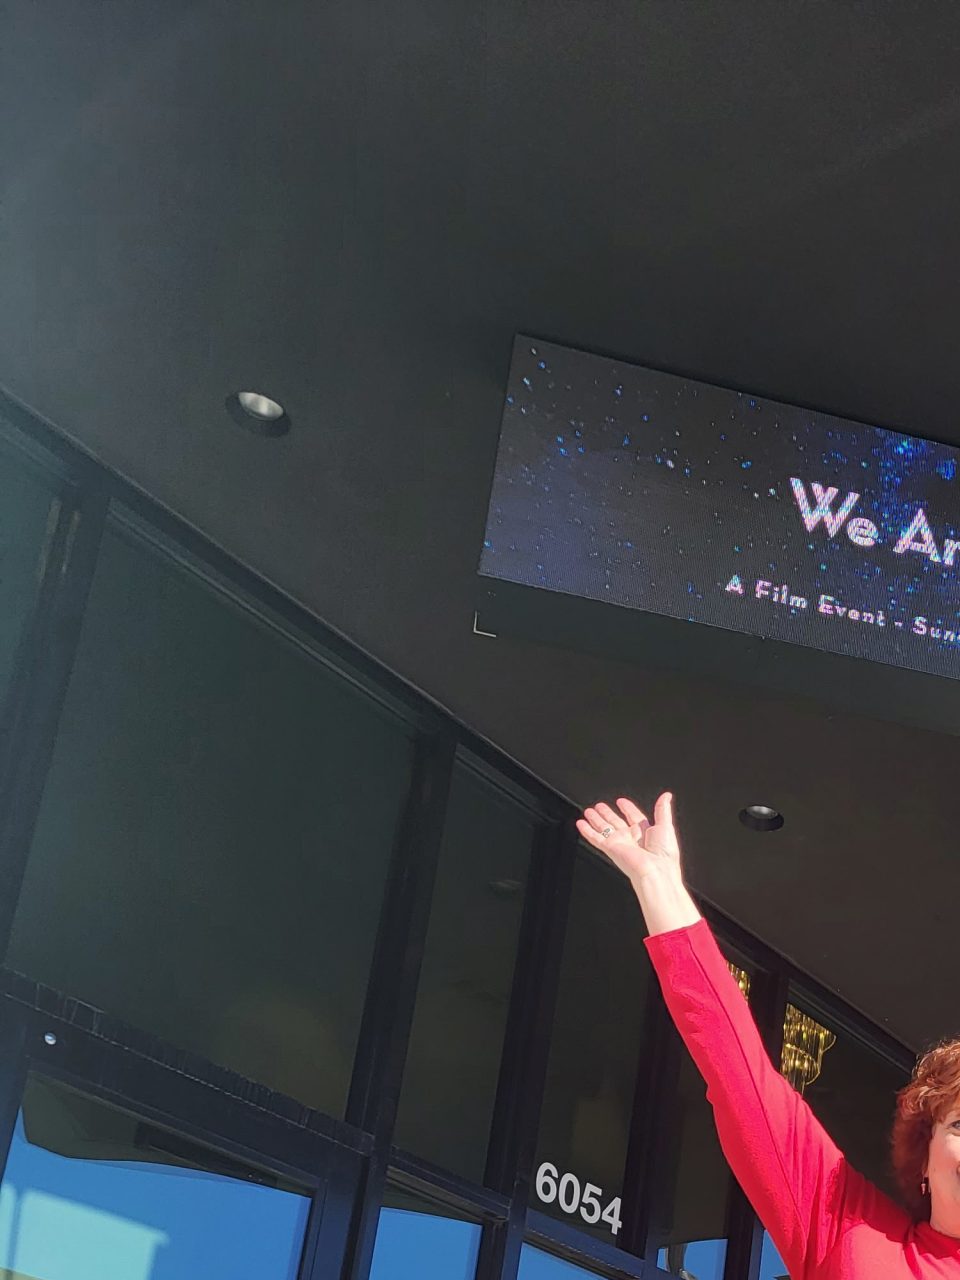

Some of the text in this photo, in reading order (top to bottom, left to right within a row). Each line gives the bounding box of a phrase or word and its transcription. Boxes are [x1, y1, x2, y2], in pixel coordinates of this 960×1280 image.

[789, 476, 879, 547] We
[725, 574, 744, 595] A
[755, 579, 808, 610] Film
[818, 594, 886, 627] Event
[535, 1161, 623, 1236] 6054
